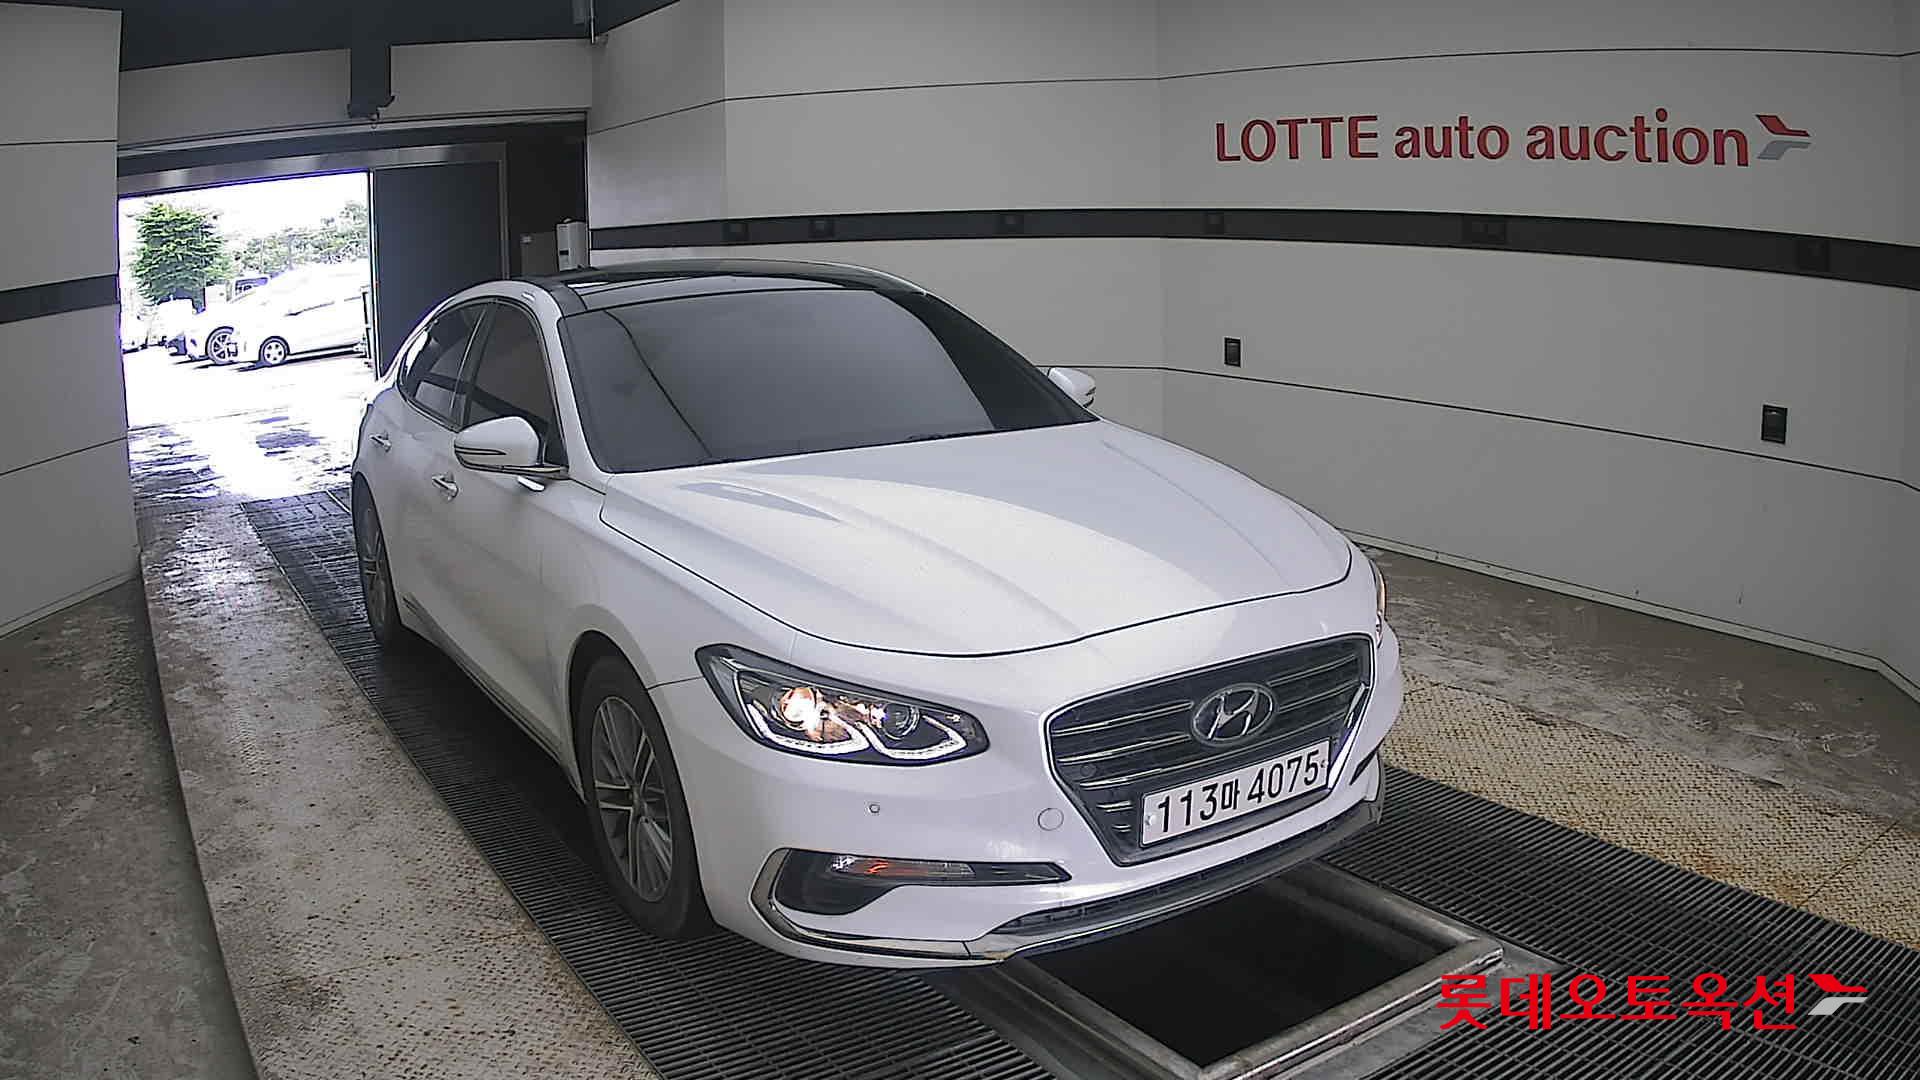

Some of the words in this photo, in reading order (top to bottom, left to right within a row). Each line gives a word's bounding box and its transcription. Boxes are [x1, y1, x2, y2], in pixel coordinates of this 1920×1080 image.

[1216, 115, 1379, 162] LOTTE
[1394, 115, 1510, 160] auto
[1525, 108, 1750, 168] auction
[1158, 778, 1240, 833] 113마
[1247, 749, 1320, 804] 4075
